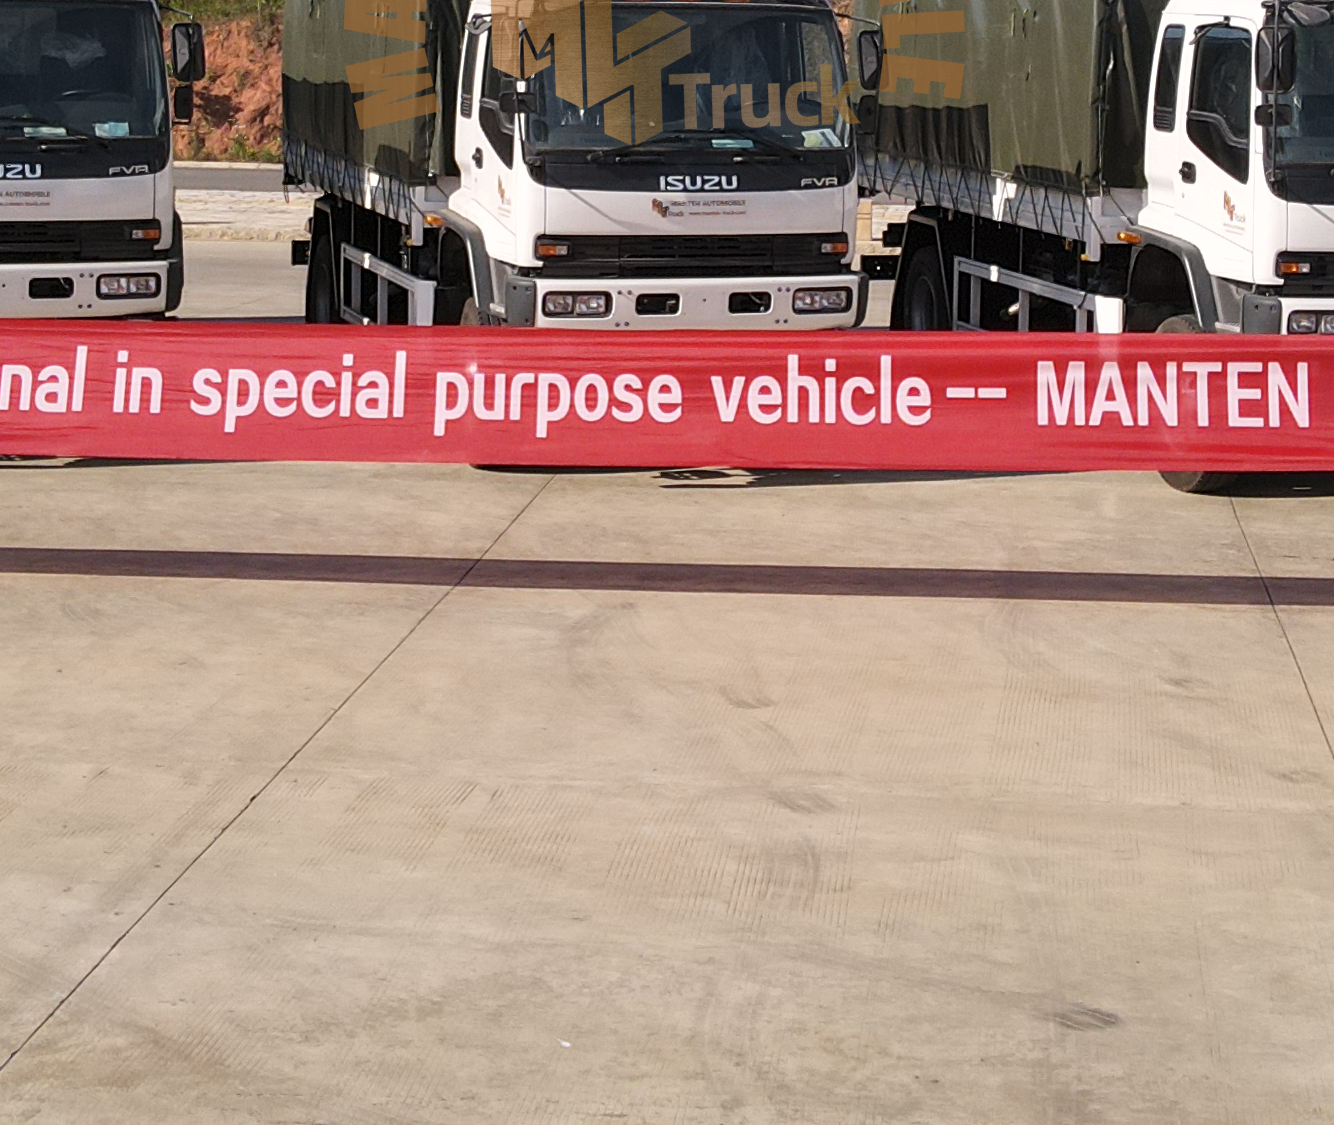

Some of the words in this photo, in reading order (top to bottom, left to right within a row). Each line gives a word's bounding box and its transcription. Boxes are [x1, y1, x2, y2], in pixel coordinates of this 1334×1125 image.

[109, 164, 149, 176] FVR
[659, 175, 738, 191] ISUZU
[800, 177, 839, 187] FVR
[112, 349, 163, 414] in
[190, 350, 407, 433] special
[433, 362, 682, 438] purpose
[1037, 360, 1310, 428] MANTEN
